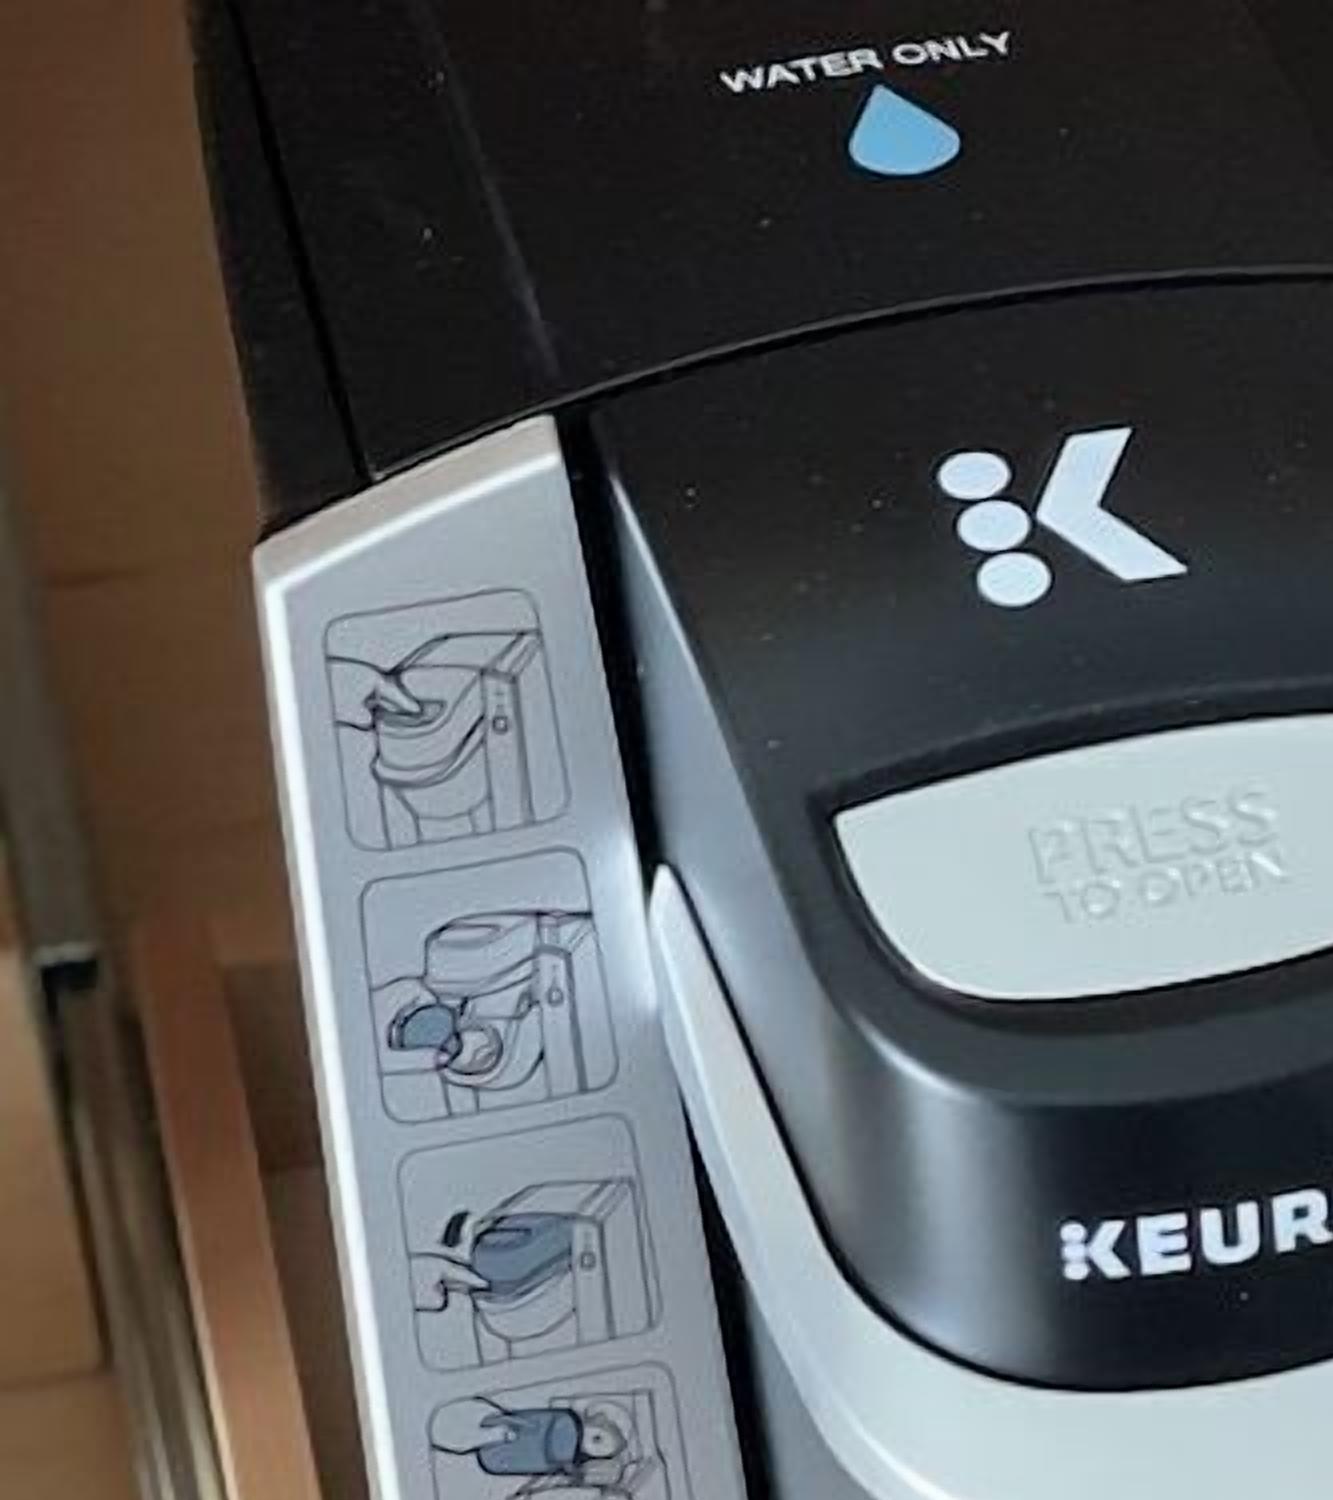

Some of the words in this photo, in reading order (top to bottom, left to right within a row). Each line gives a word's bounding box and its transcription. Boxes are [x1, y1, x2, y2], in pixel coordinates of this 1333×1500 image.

[718, 48, 885, 94] WATER
[891, 31, 1012, 66] ONLY
[1028, 791, 1279, 885] PRESS
[1041, 877, 1122, 925] TO
[1137, 850, 1290, 907] OPEN
